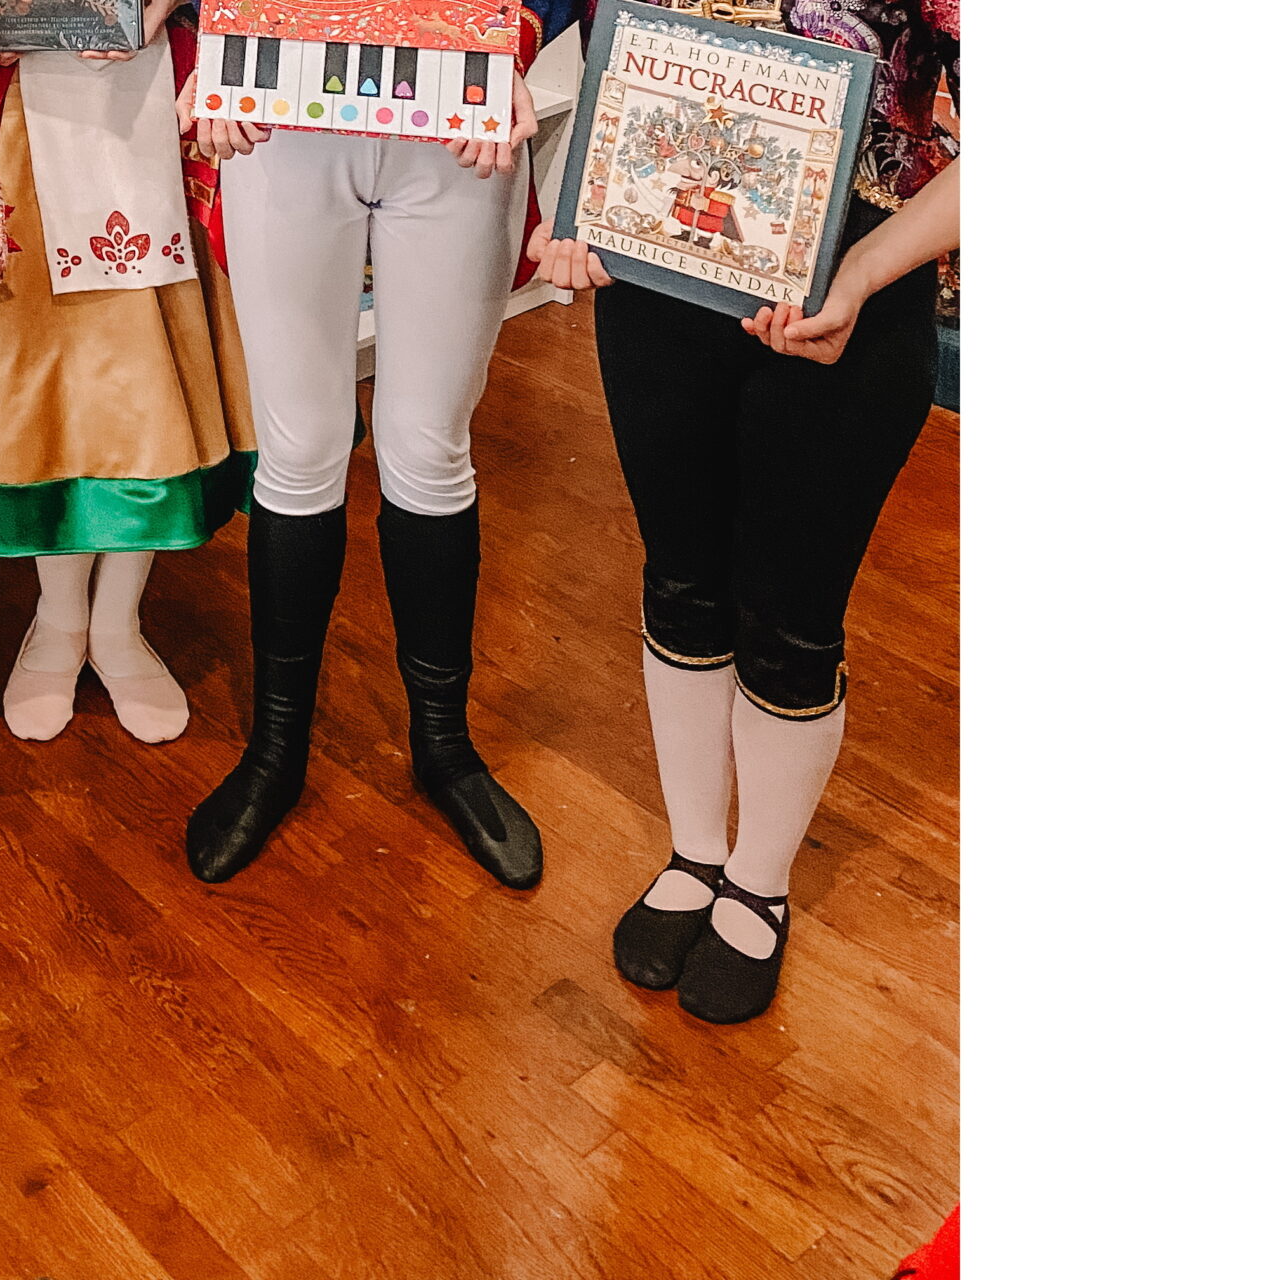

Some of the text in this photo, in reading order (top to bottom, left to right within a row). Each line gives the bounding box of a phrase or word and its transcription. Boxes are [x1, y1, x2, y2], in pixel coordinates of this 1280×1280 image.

[622, 51, 829, 125] NUTCRACKER
[688, 47, 831, 91] HOFFMANN
[586, 227, 795, 303] MAURICE SENDAK
